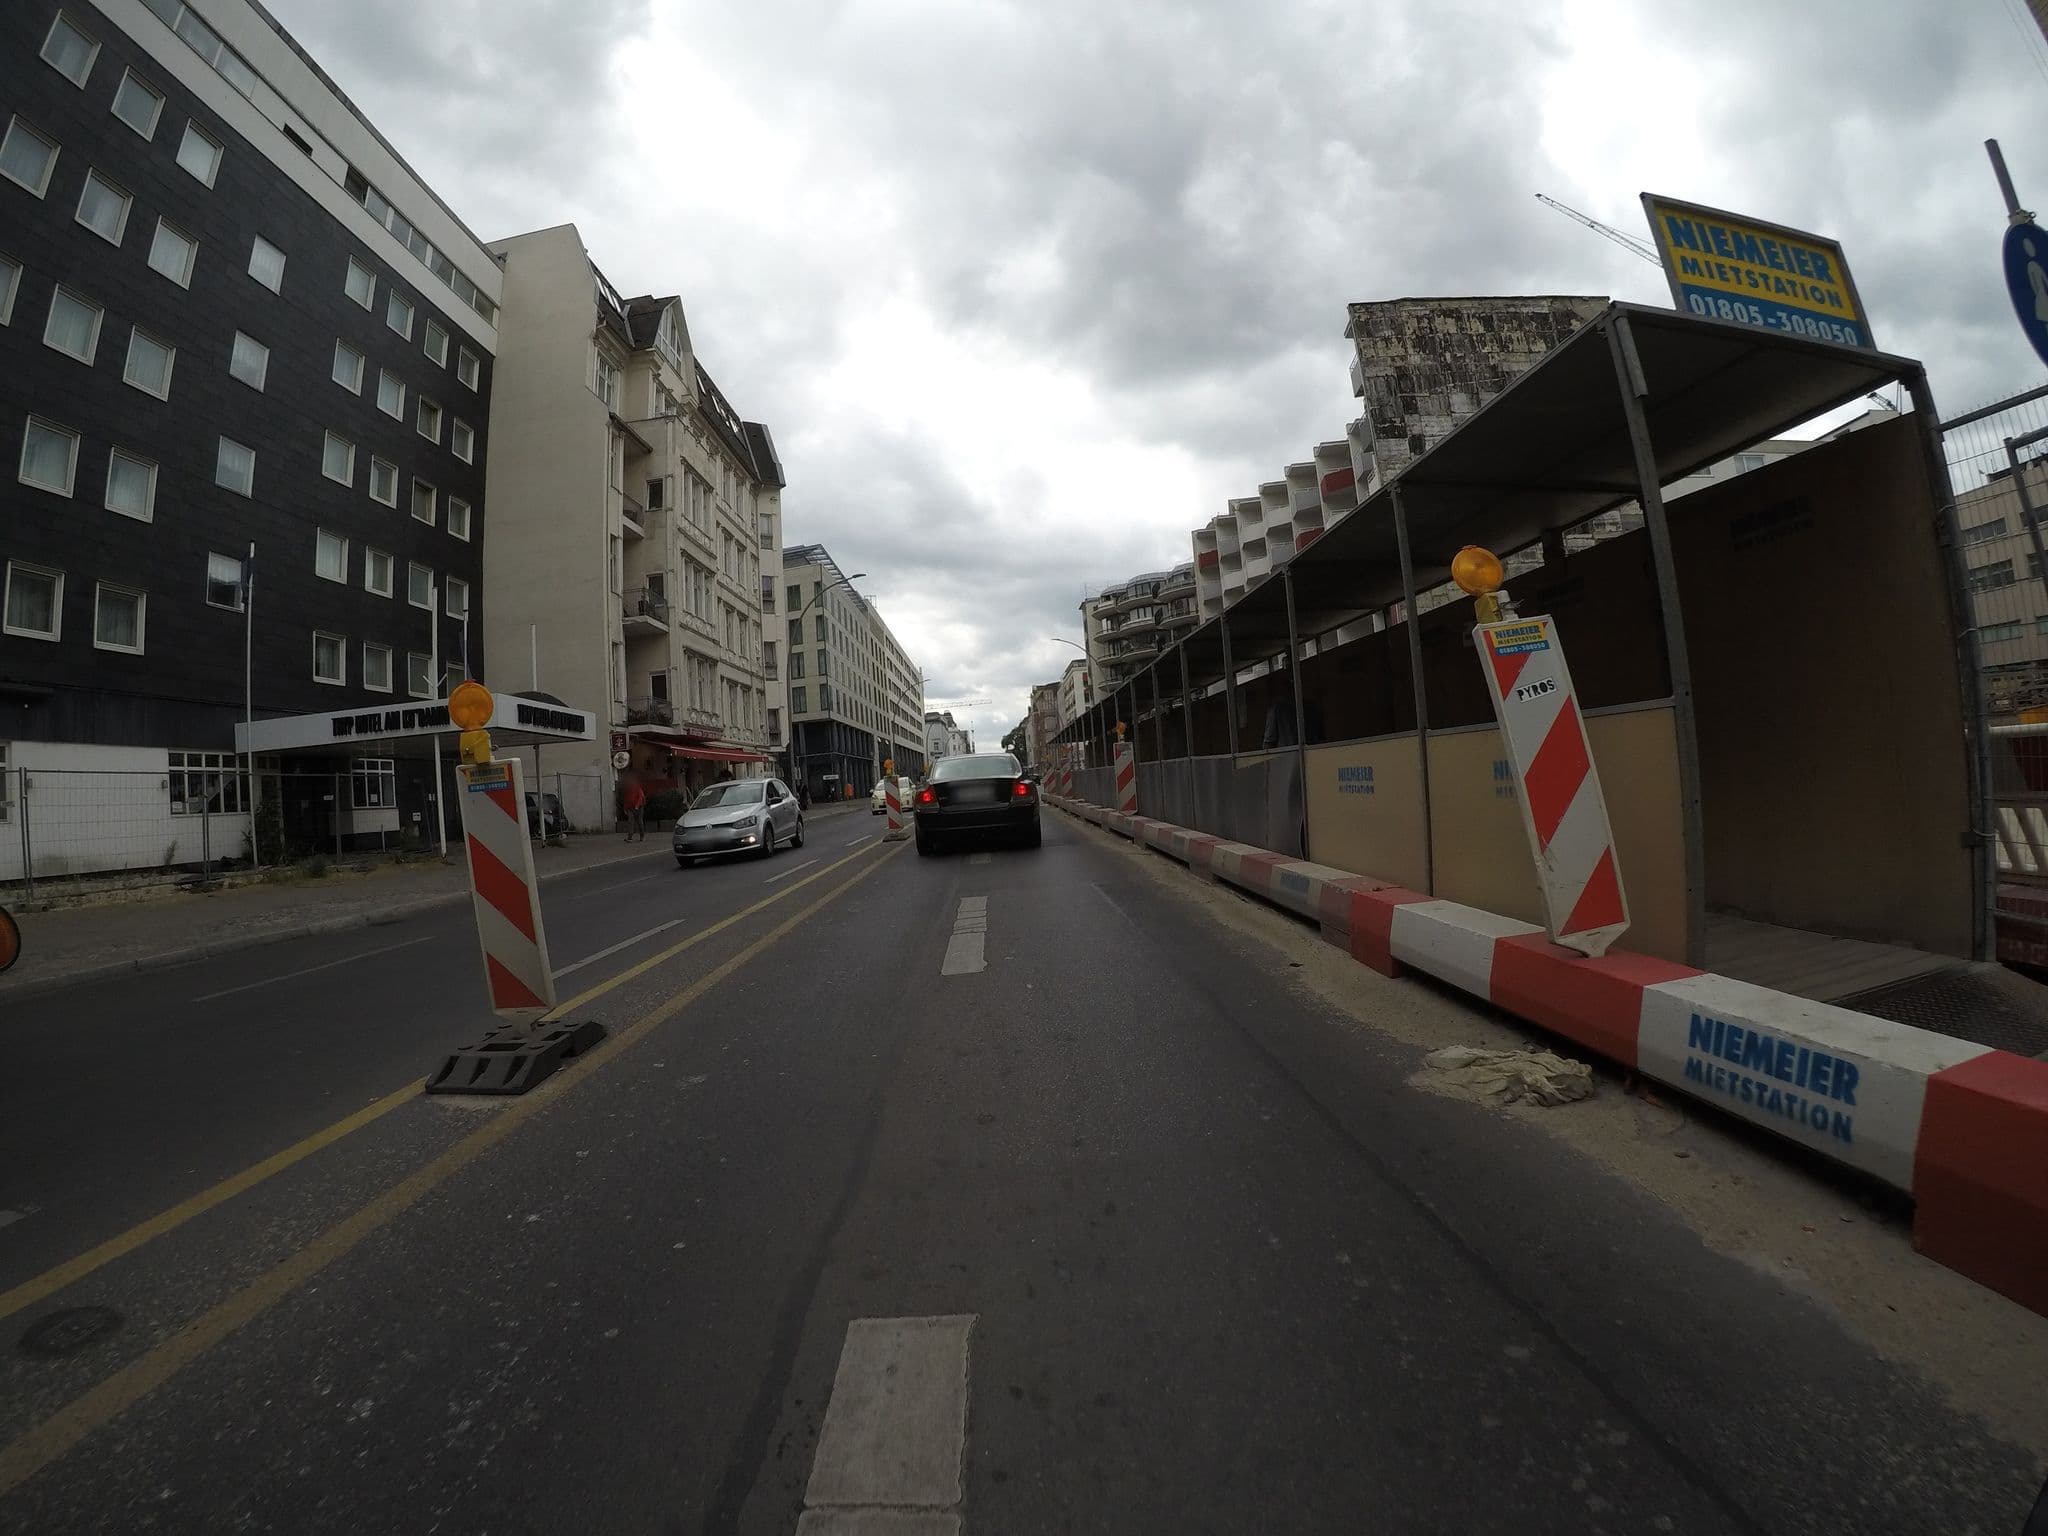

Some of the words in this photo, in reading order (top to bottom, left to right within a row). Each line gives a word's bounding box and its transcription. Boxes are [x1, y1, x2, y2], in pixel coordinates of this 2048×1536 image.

[1665, 215, 1835, 285] NIEMEIER
[1680, 255, 1844, 309] MIETSTATION
[1516, 679, 1556, 702] PYROS
[1688, 1012, 1860, 1106] NIEMEIER
[1684, 1055, 1854, 1143] MIETSTATION
